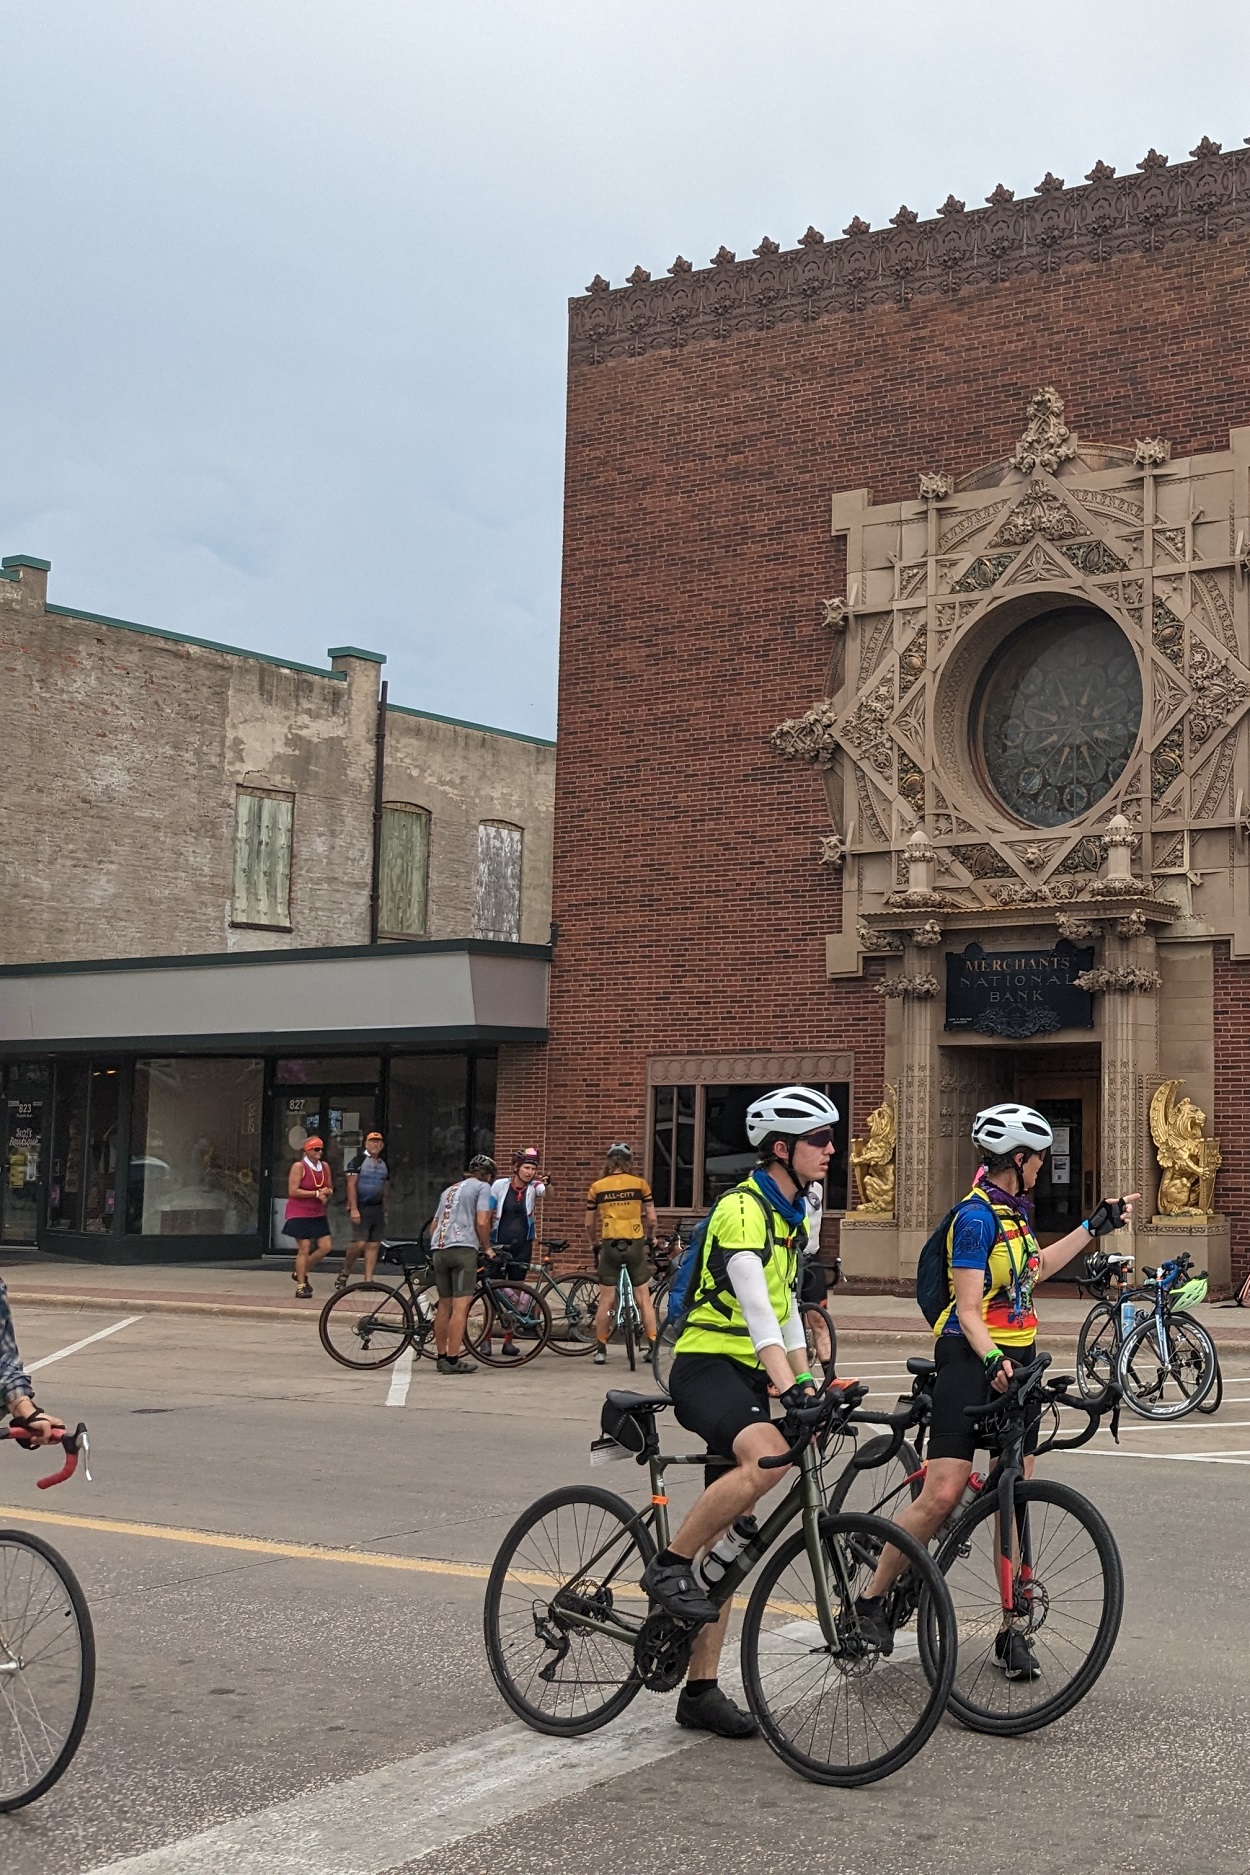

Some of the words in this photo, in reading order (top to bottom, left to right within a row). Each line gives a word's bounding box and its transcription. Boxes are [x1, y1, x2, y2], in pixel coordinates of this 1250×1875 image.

[966, 957, 1070, 972] MERCHANTS
[960, 975, 1075, 987] NATIONAL
[989, 990, 1044, 1003] BANK
[18, 1103, 32, 1114] 823
[289, 1099, 306, 1110] 827
[604, 1191, 636, 1200] ALL-CITY
